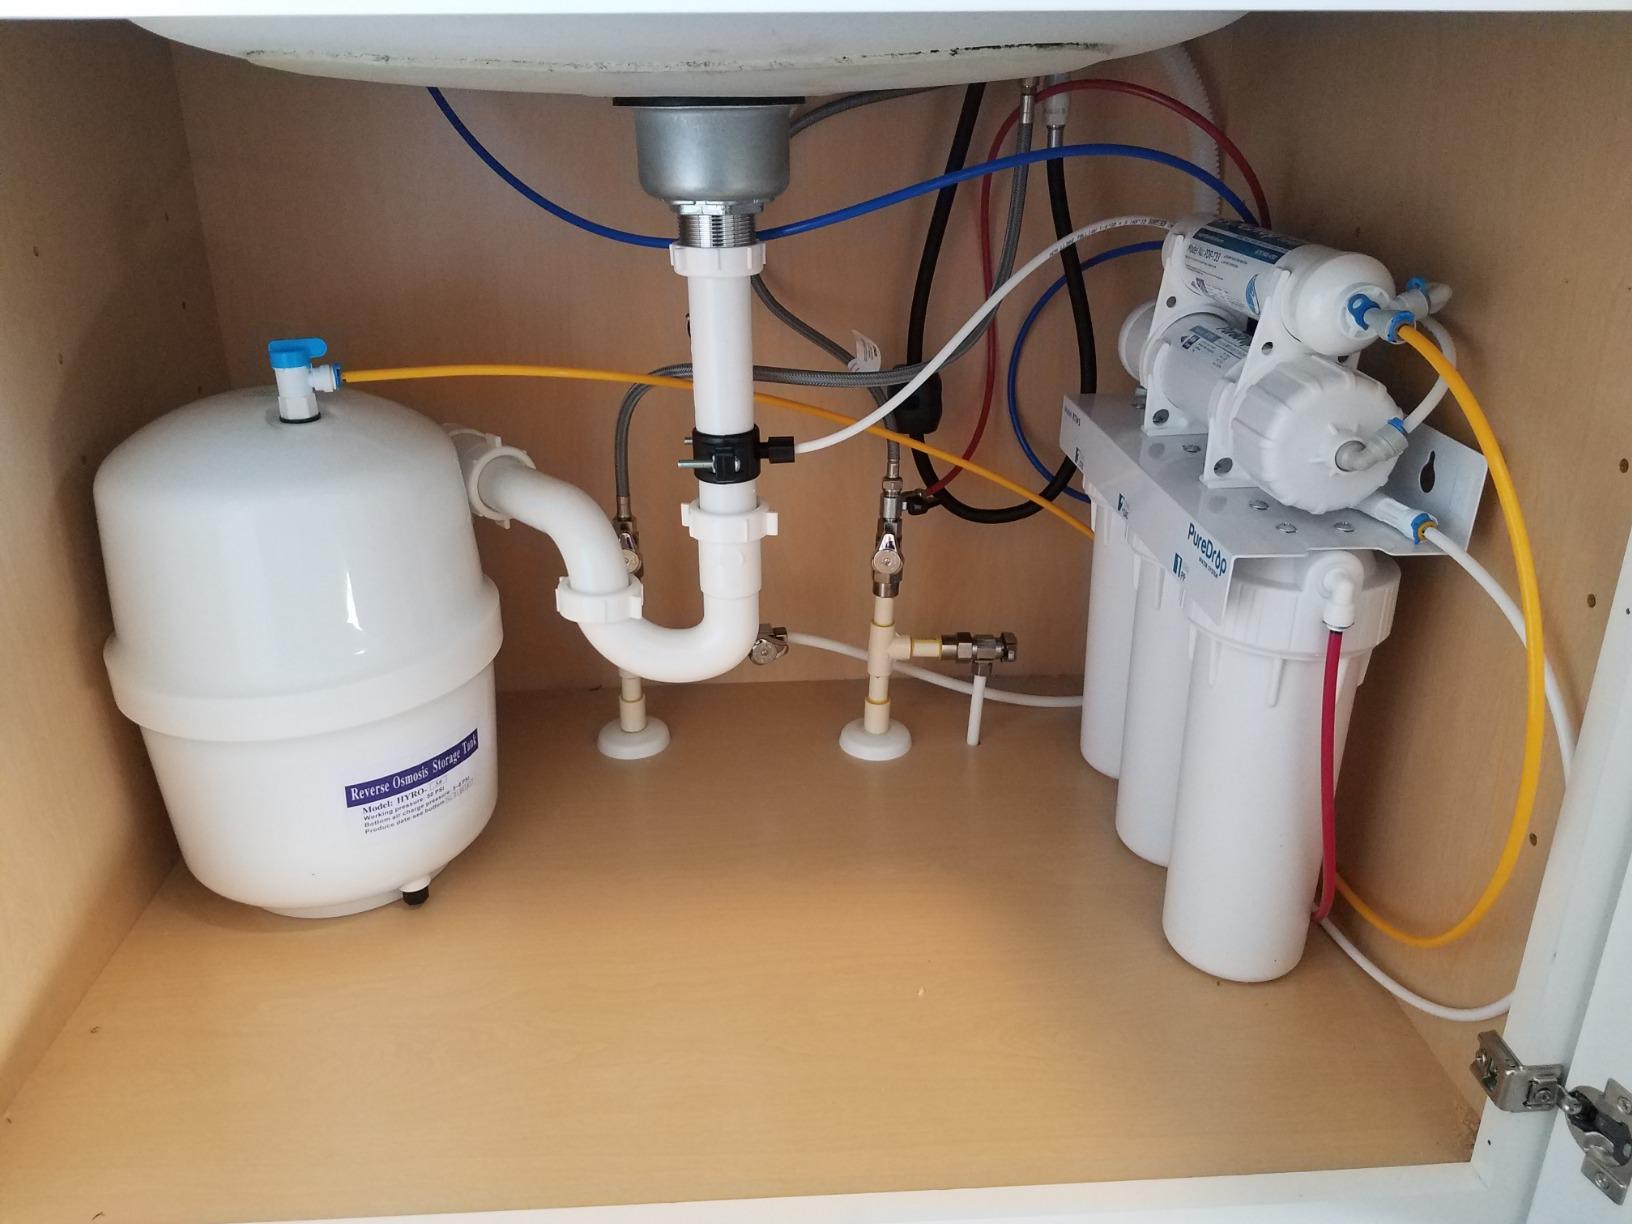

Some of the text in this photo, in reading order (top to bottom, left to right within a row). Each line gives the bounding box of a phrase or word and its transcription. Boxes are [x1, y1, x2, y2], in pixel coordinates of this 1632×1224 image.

[1187, 522, 1227, 577] PureDrop
[350, 733, 478, 801] Reverse Osmosis Storage Tank
[362, 800, 393, 815] Model:
[363, 809, 394, 821] Working
